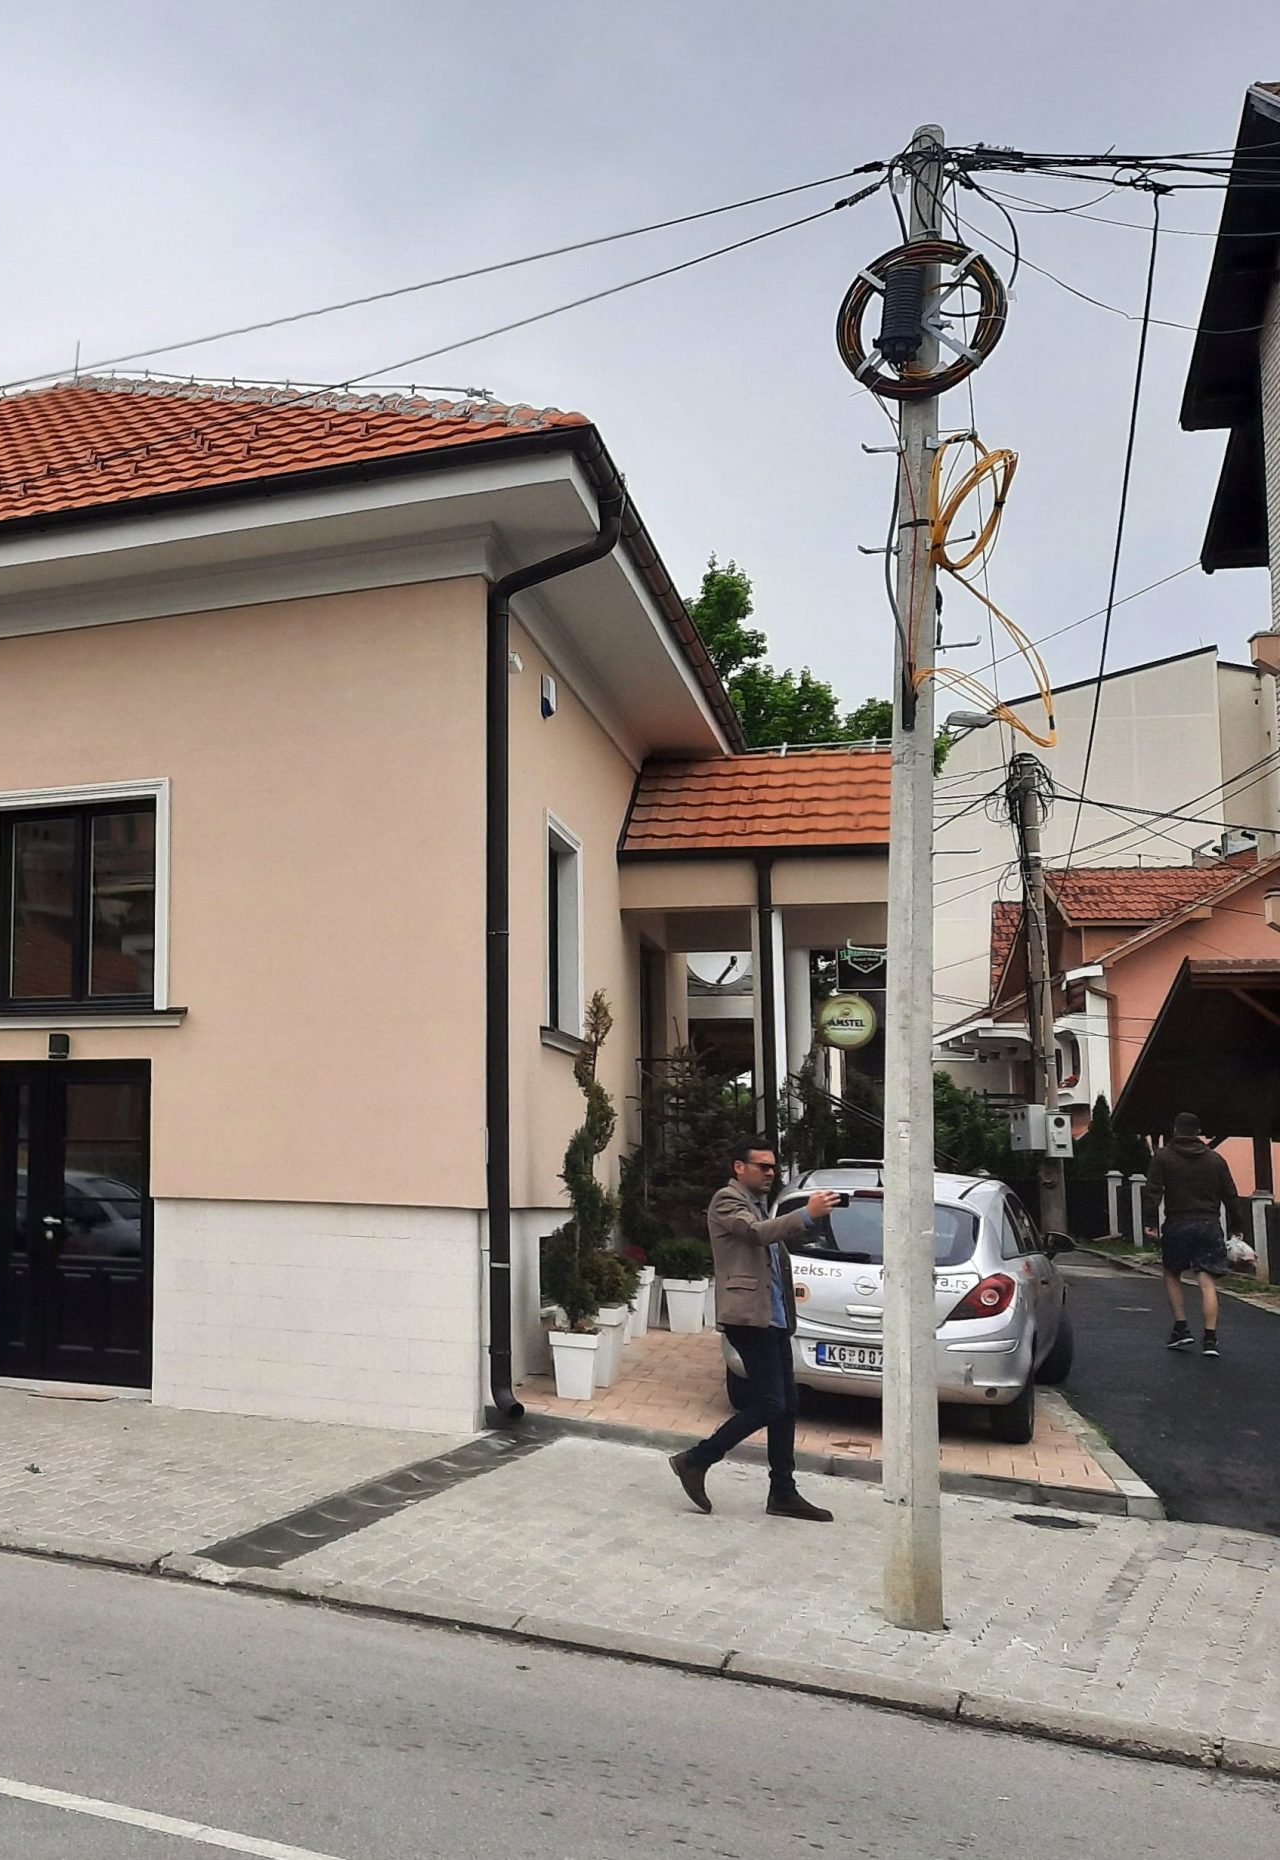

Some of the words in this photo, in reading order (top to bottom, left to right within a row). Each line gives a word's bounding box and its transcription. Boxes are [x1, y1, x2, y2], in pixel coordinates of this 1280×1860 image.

[826, 1017, 865, 1027] AMSTEL
[793, 1264, 842, 1278] zeks.rs
[828, 1346, 847, 1361] KG
